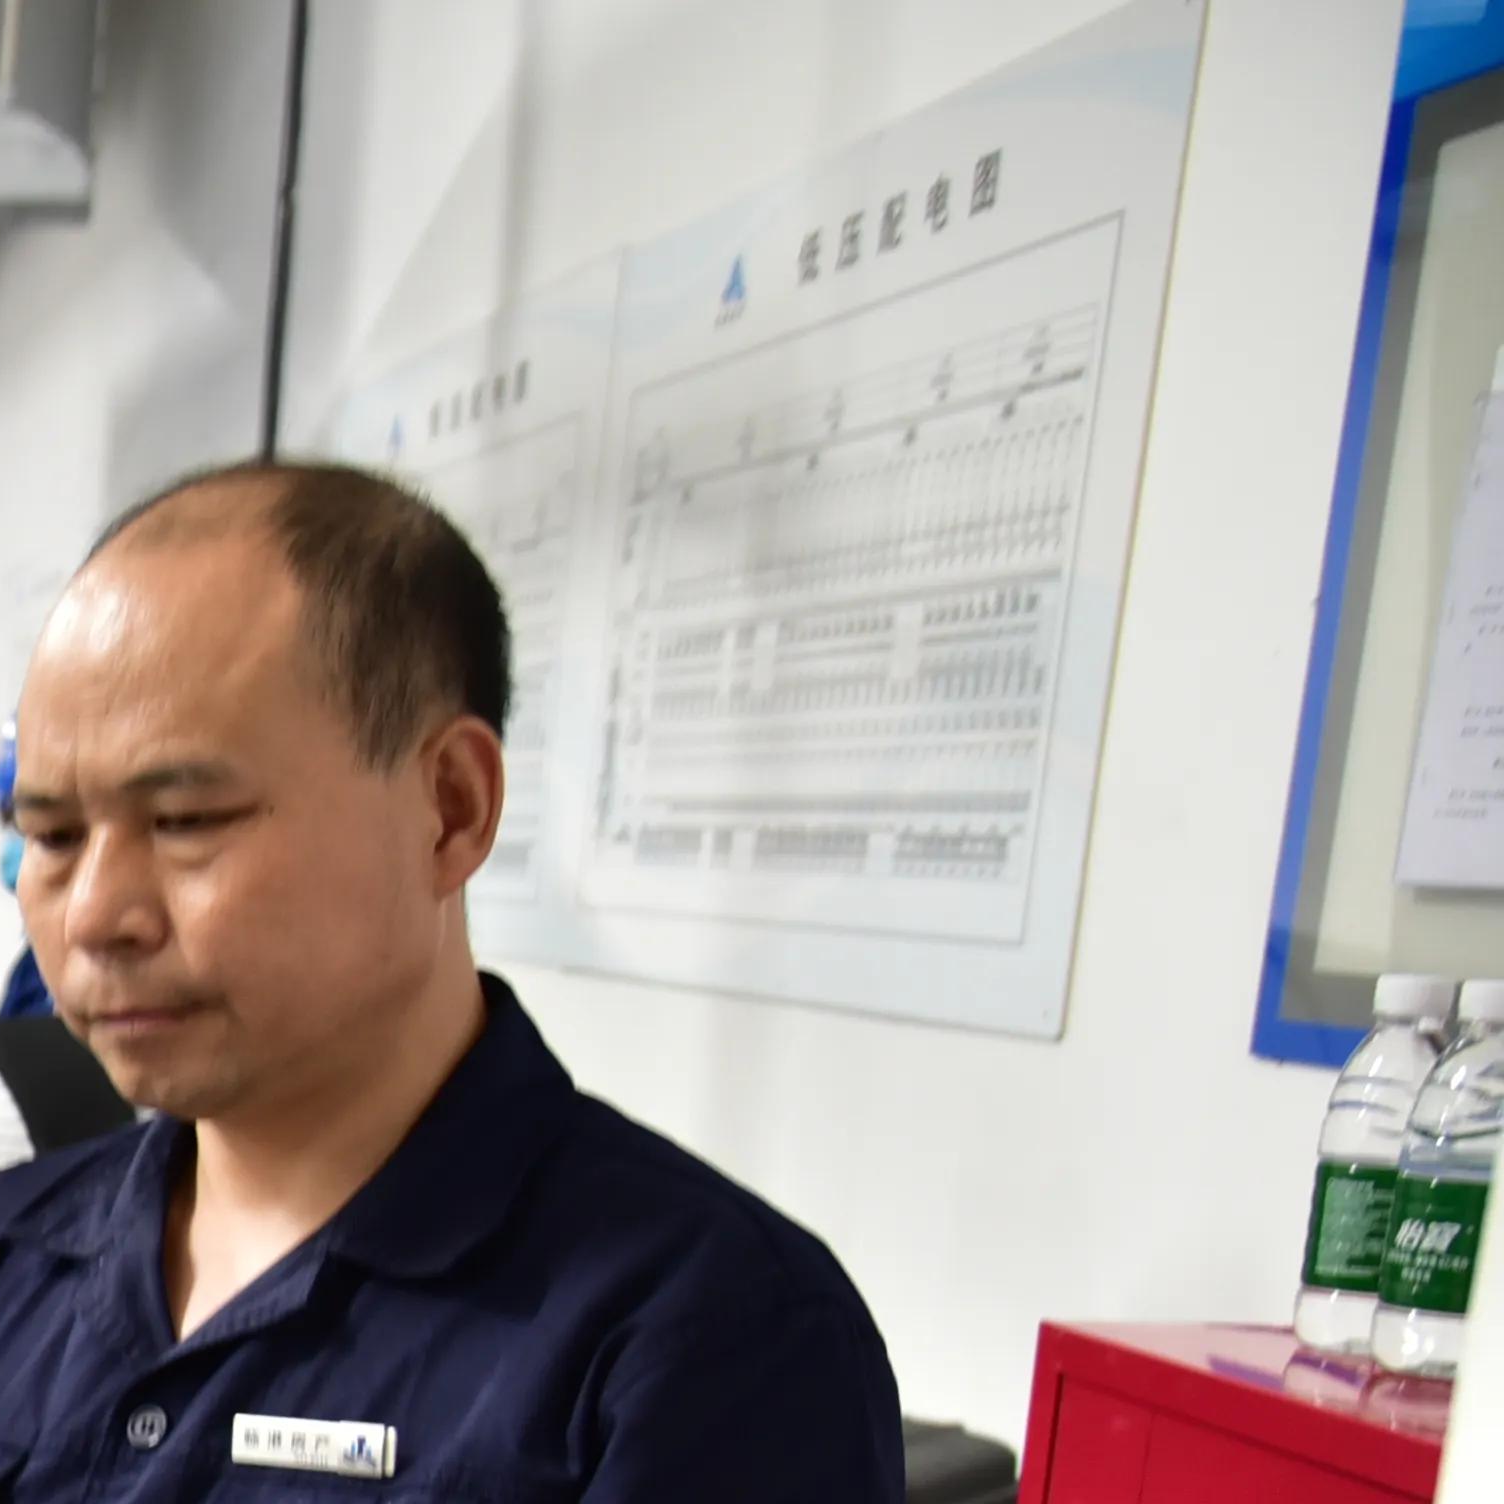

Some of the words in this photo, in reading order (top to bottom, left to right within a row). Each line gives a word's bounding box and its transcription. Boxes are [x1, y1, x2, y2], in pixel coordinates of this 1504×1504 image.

[797, 146, 1004, 287] 低压配电图
